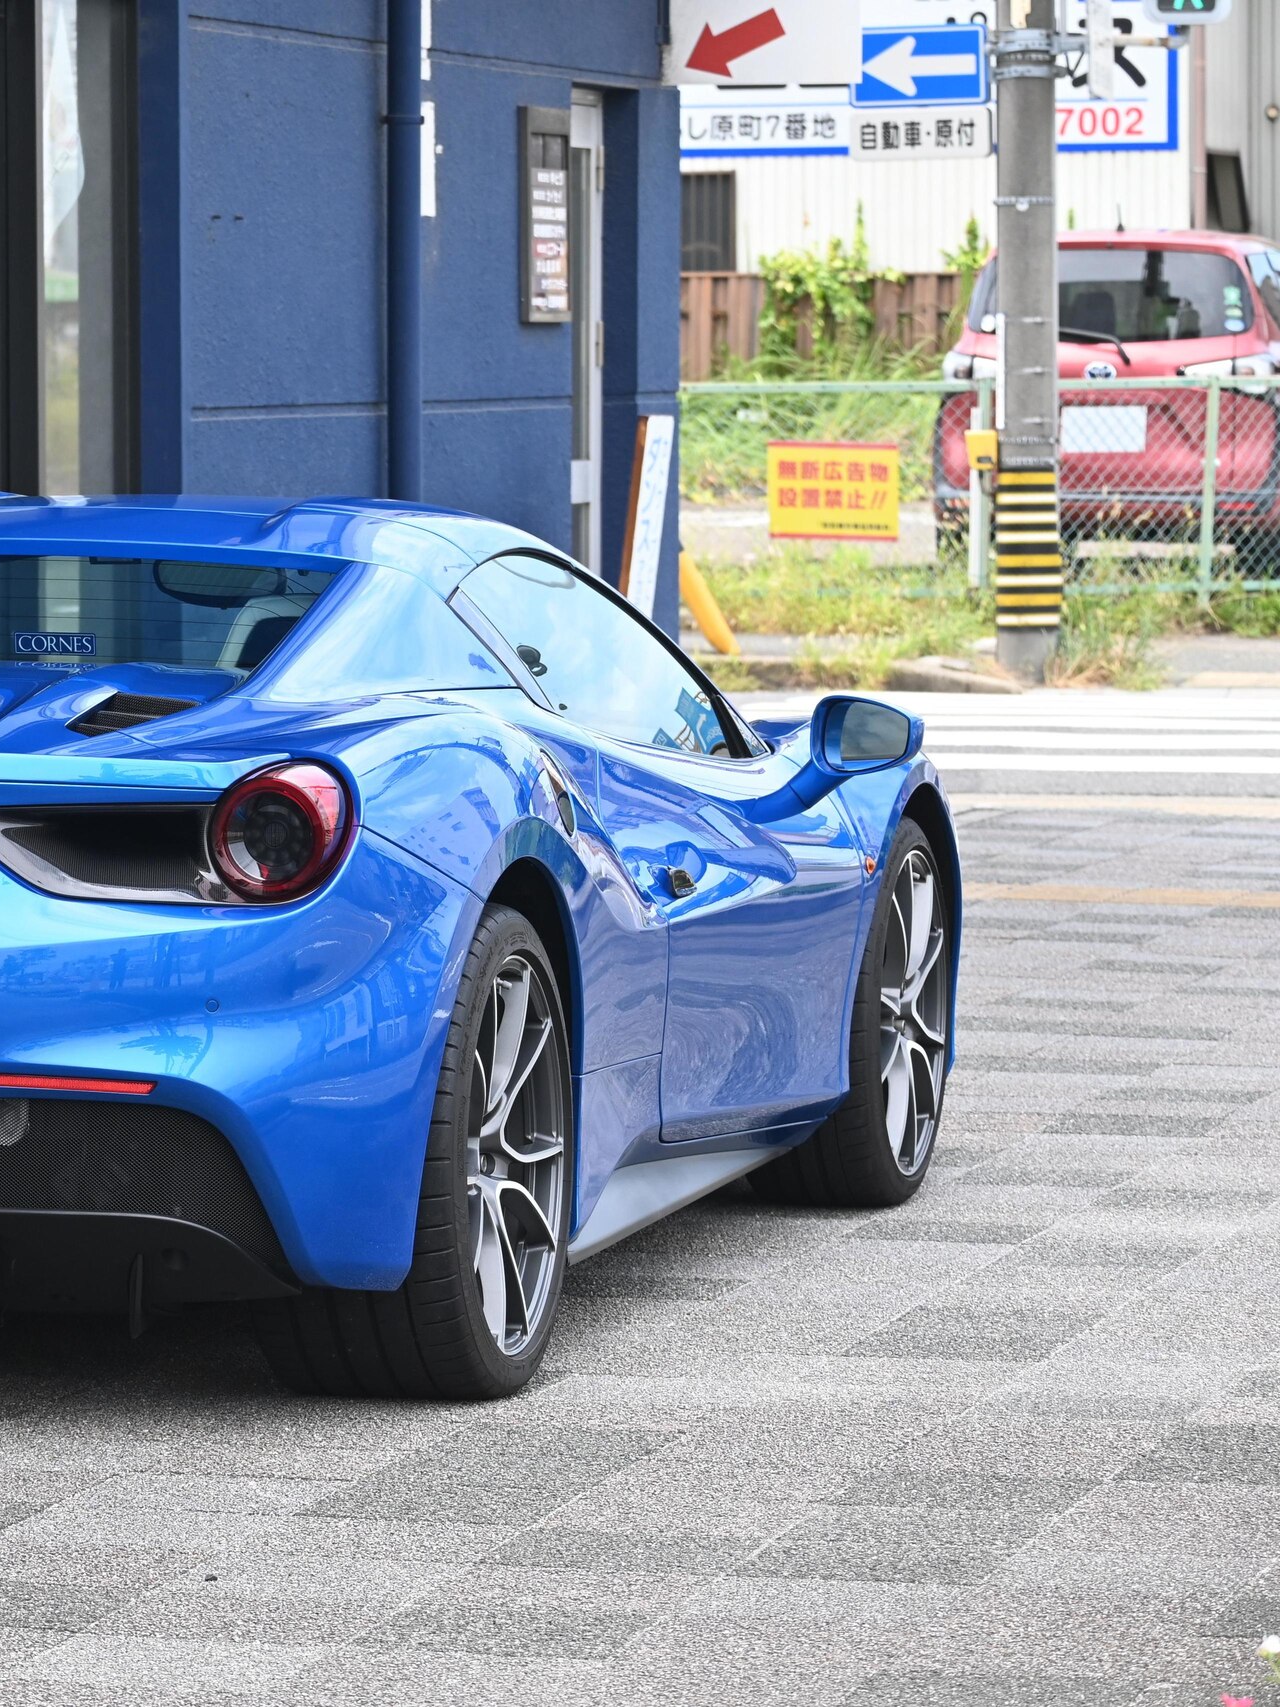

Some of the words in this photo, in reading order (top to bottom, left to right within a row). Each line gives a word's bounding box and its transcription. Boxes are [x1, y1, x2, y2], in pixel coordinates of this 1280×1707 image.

[680, 113, 836, 141] し原町7番地
[860, 118, 976, 151] 自動車・原付
[1056, 107, 1145, 137] 7002
[18, 635, 92, 653] CORNES
